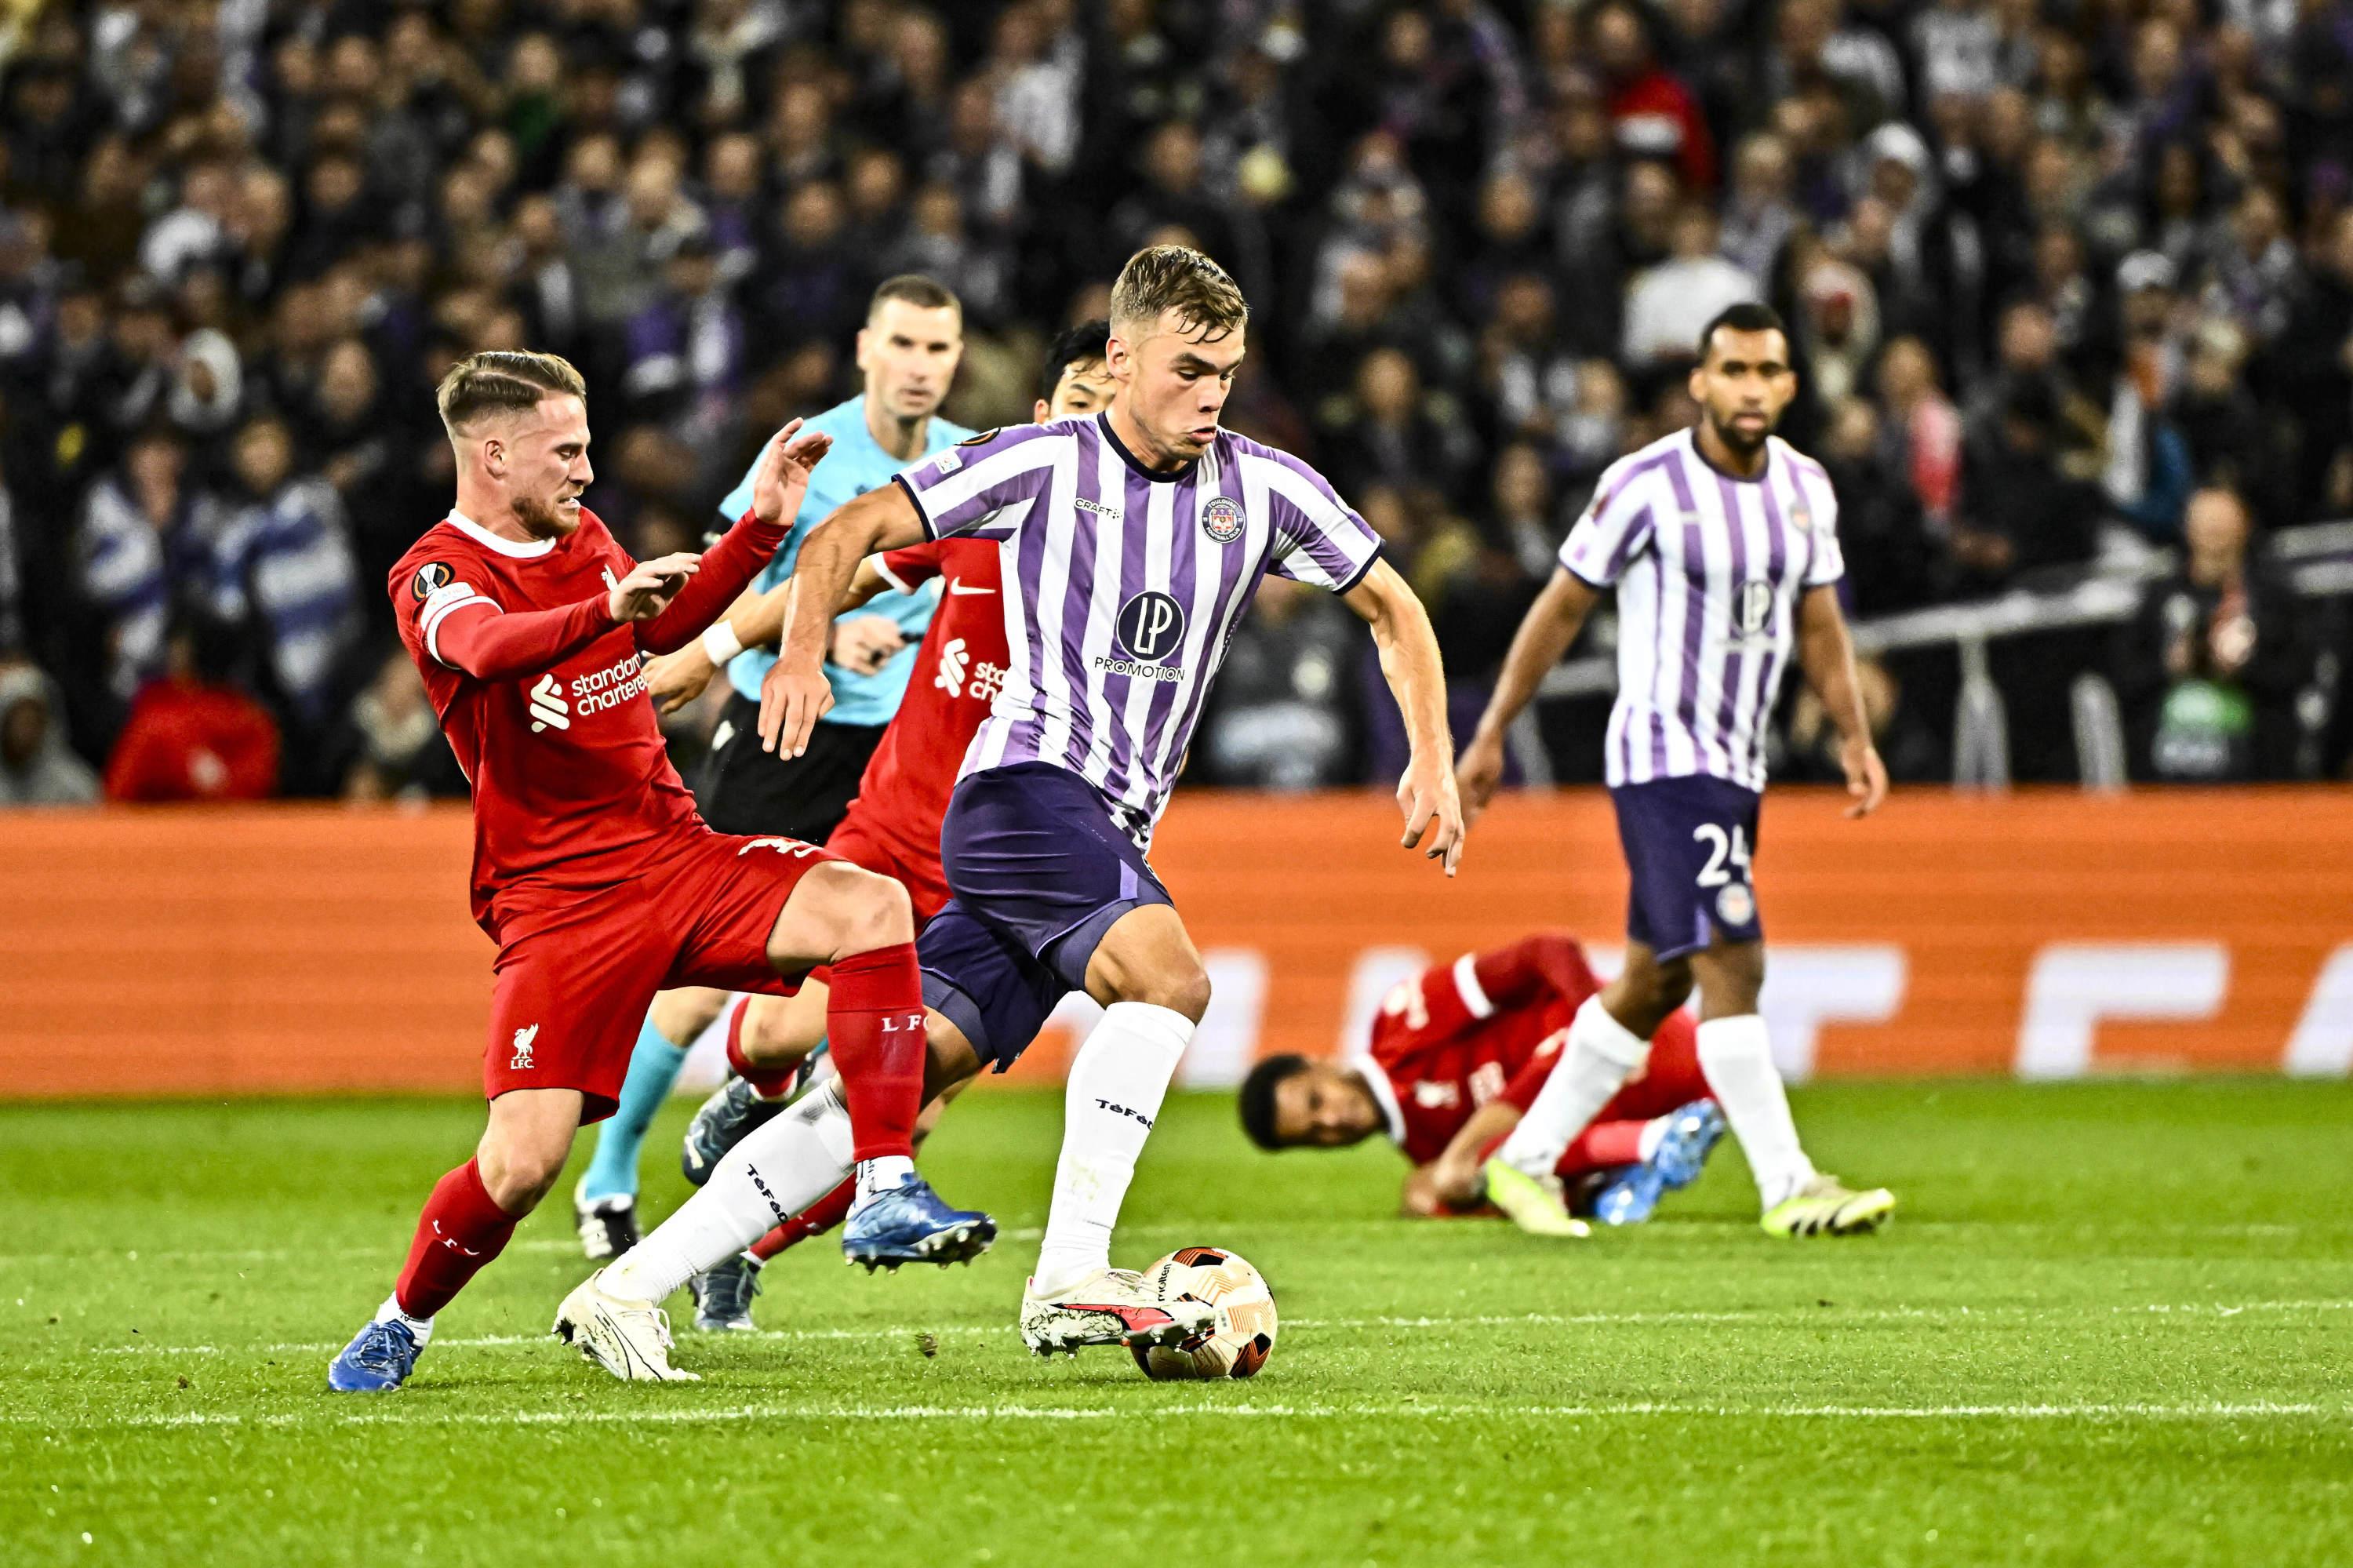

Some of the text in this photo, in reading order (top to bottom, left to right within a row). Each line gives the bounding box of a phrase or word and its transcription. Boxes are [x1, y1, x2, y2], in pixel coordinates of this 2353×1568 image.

[1075, 499, 1112, 515] CRAFT
[1094, 657, 1185, 681] PROMOTION
[1693, 823, 1753, 888] 24
